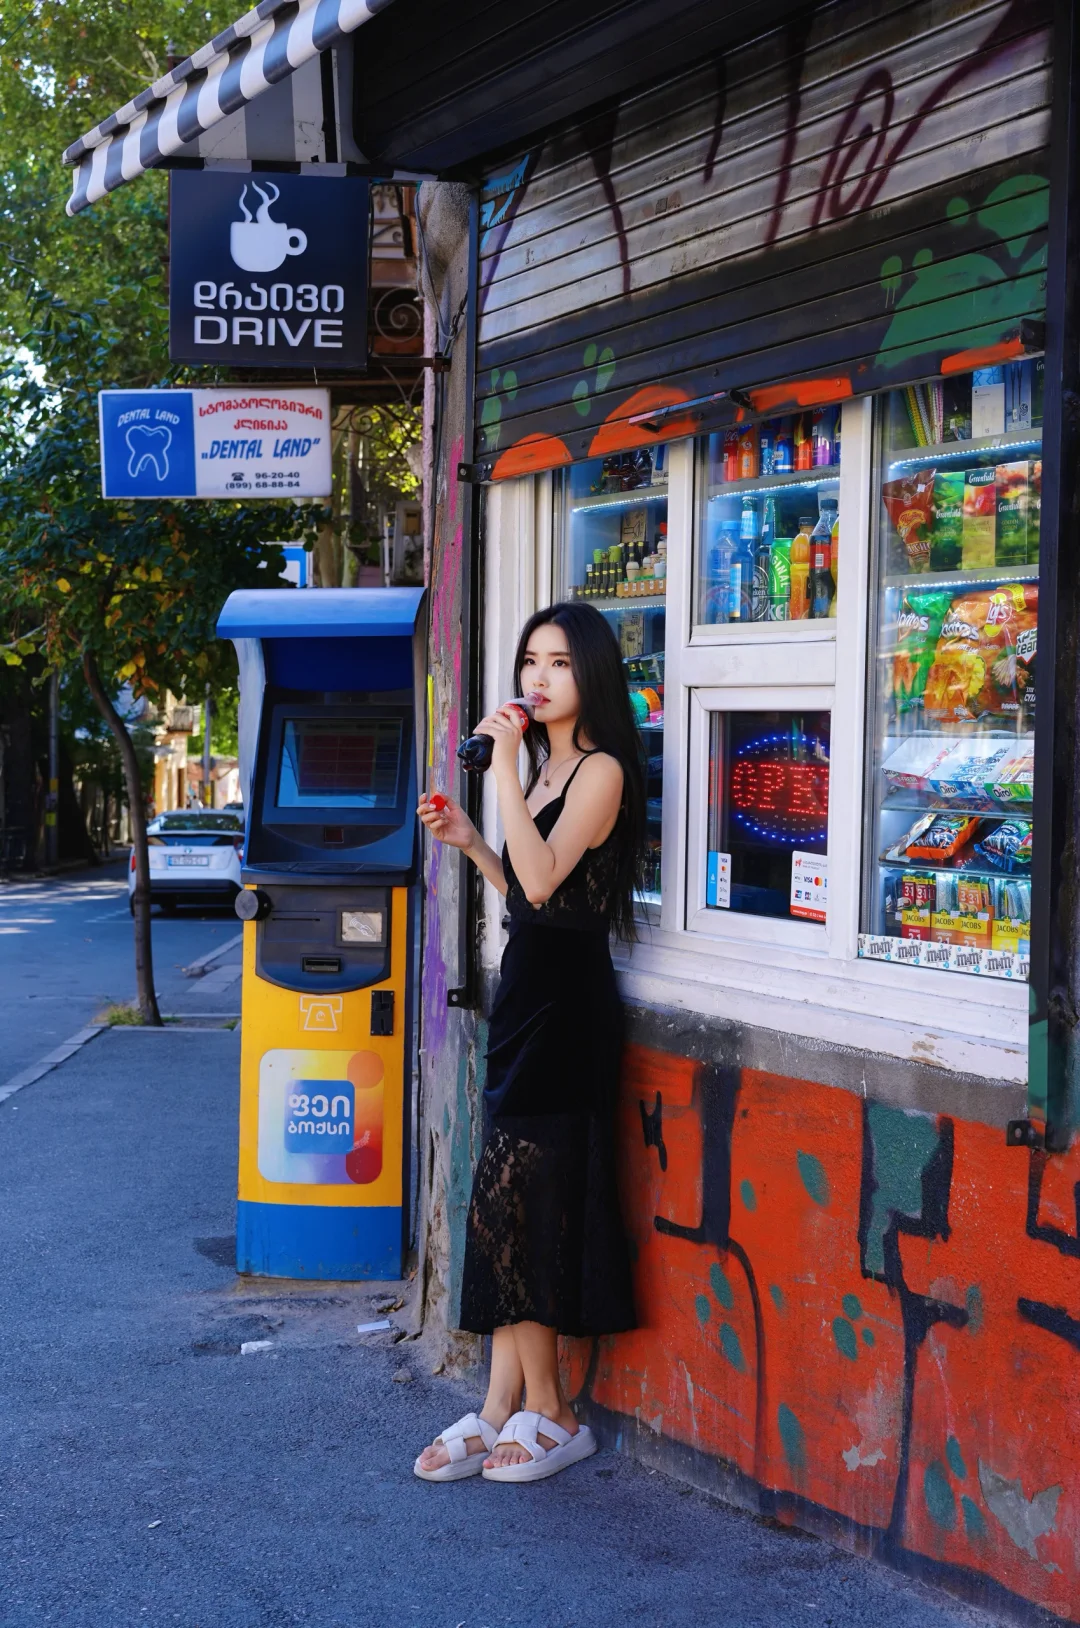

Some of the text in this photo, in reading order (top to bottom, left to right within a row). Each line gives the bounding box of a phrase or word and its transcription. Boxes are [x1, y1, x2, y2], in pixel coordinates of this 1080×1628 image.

[194, 281, 344, 312] დრაივი
[194, 316, 343, 348] DRIVE
[198, 397, 323, 420] სტომატოლოგიური
[117, 408, 181, 428] DENTAL LAND
[233, 419, 288, 431] კლინიკა
[968, 471, 996, 483] Greenfield
[225, 481, 300, 490] (899) 68-88-84
[939, 785, 957, 795] Dirol
[993, 787, 1012, 798] Dirol
[803, 876, 813, 884] VISA
[905, 914, 925, 923] JACOBS
[934, 918, 955, 926] JACOBS
[960, 921, 982, 930] JACOBS
[996, 925, 1019, 934] JACOBS
[289, 1093, 350, 1118] ფეი
[288, 1121, 350, 1136] ბოქსი
